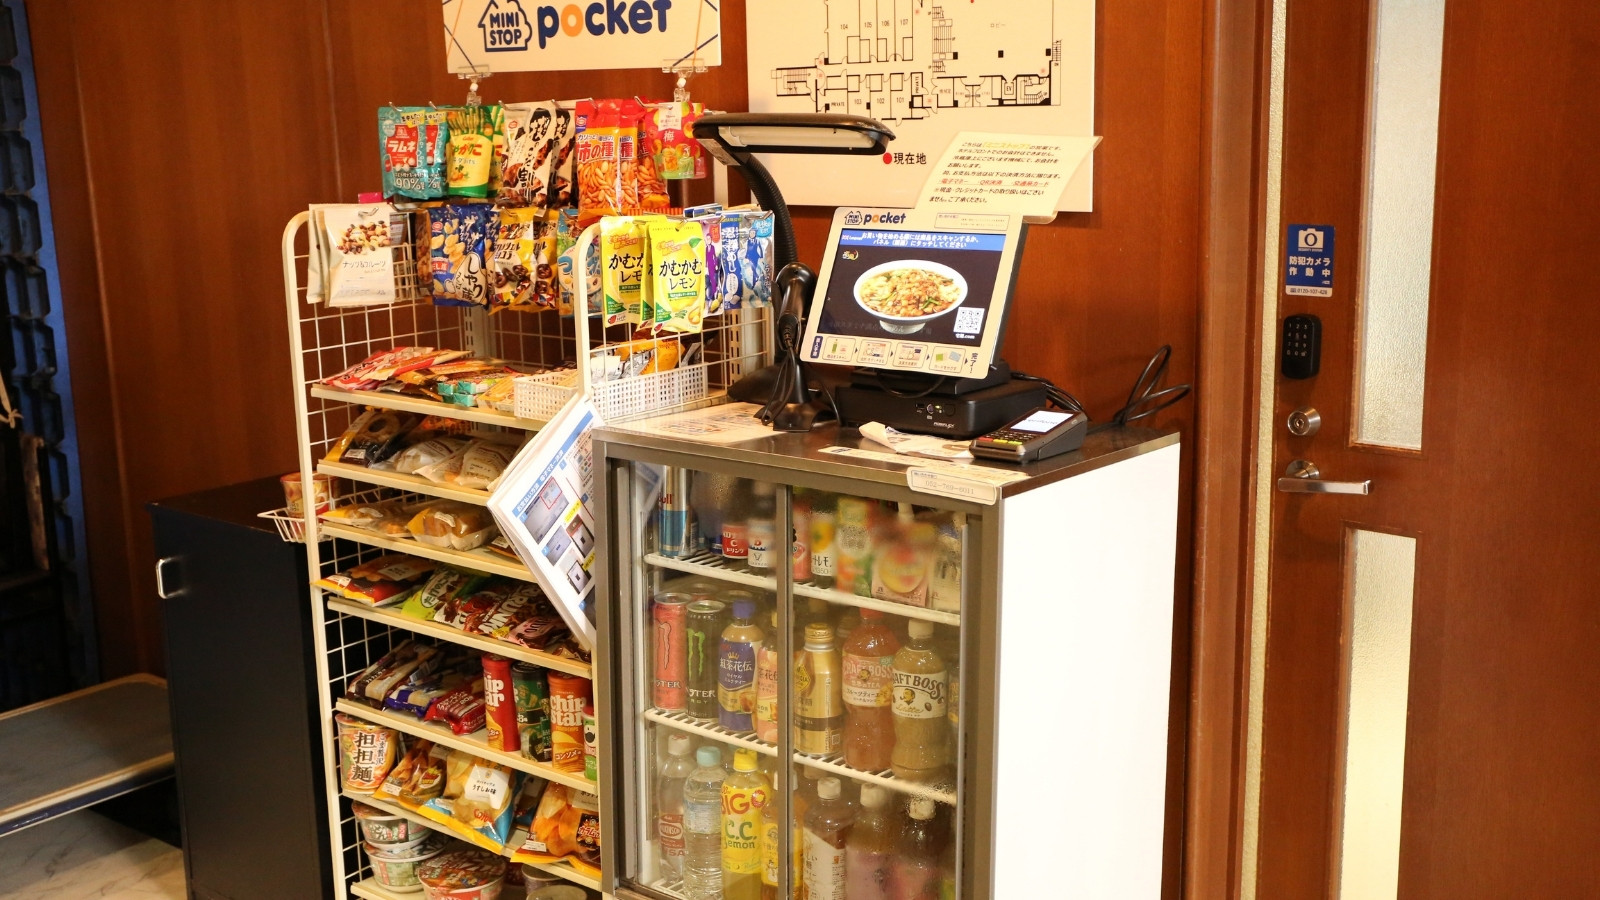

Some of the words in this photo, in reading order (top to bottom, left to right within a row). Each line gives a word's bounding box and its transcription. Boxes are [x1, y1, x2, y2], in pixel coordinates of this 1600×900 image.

[489, 12, 519, 28] MINI
[537, 0, 672, 49] pocket
[490, 29, 522, 46] STOP
[387, 140, 416, 153] ラムネ
[576, 140, 615, 162] 柿の種
[893, 152, 926, 165] 現在地
[863, 211, 906, 225] pocket
[659, 258, 702, 277] かむかむ
[1289, 256, 1331, 266] 防犯カメラ
[669, 277, 697, 291] レモン
[720, 658, 752, 672] 紅茶花伝
[912, 675, 944, 700] BOSS
[550, 694, 587, 712] chip
[550, 711, 583, 727] star
[555, 750, 578, 760] コンソメ
[472, 784, 496, 795] うすしお味
[725, 820, 758, 841] C.C.
